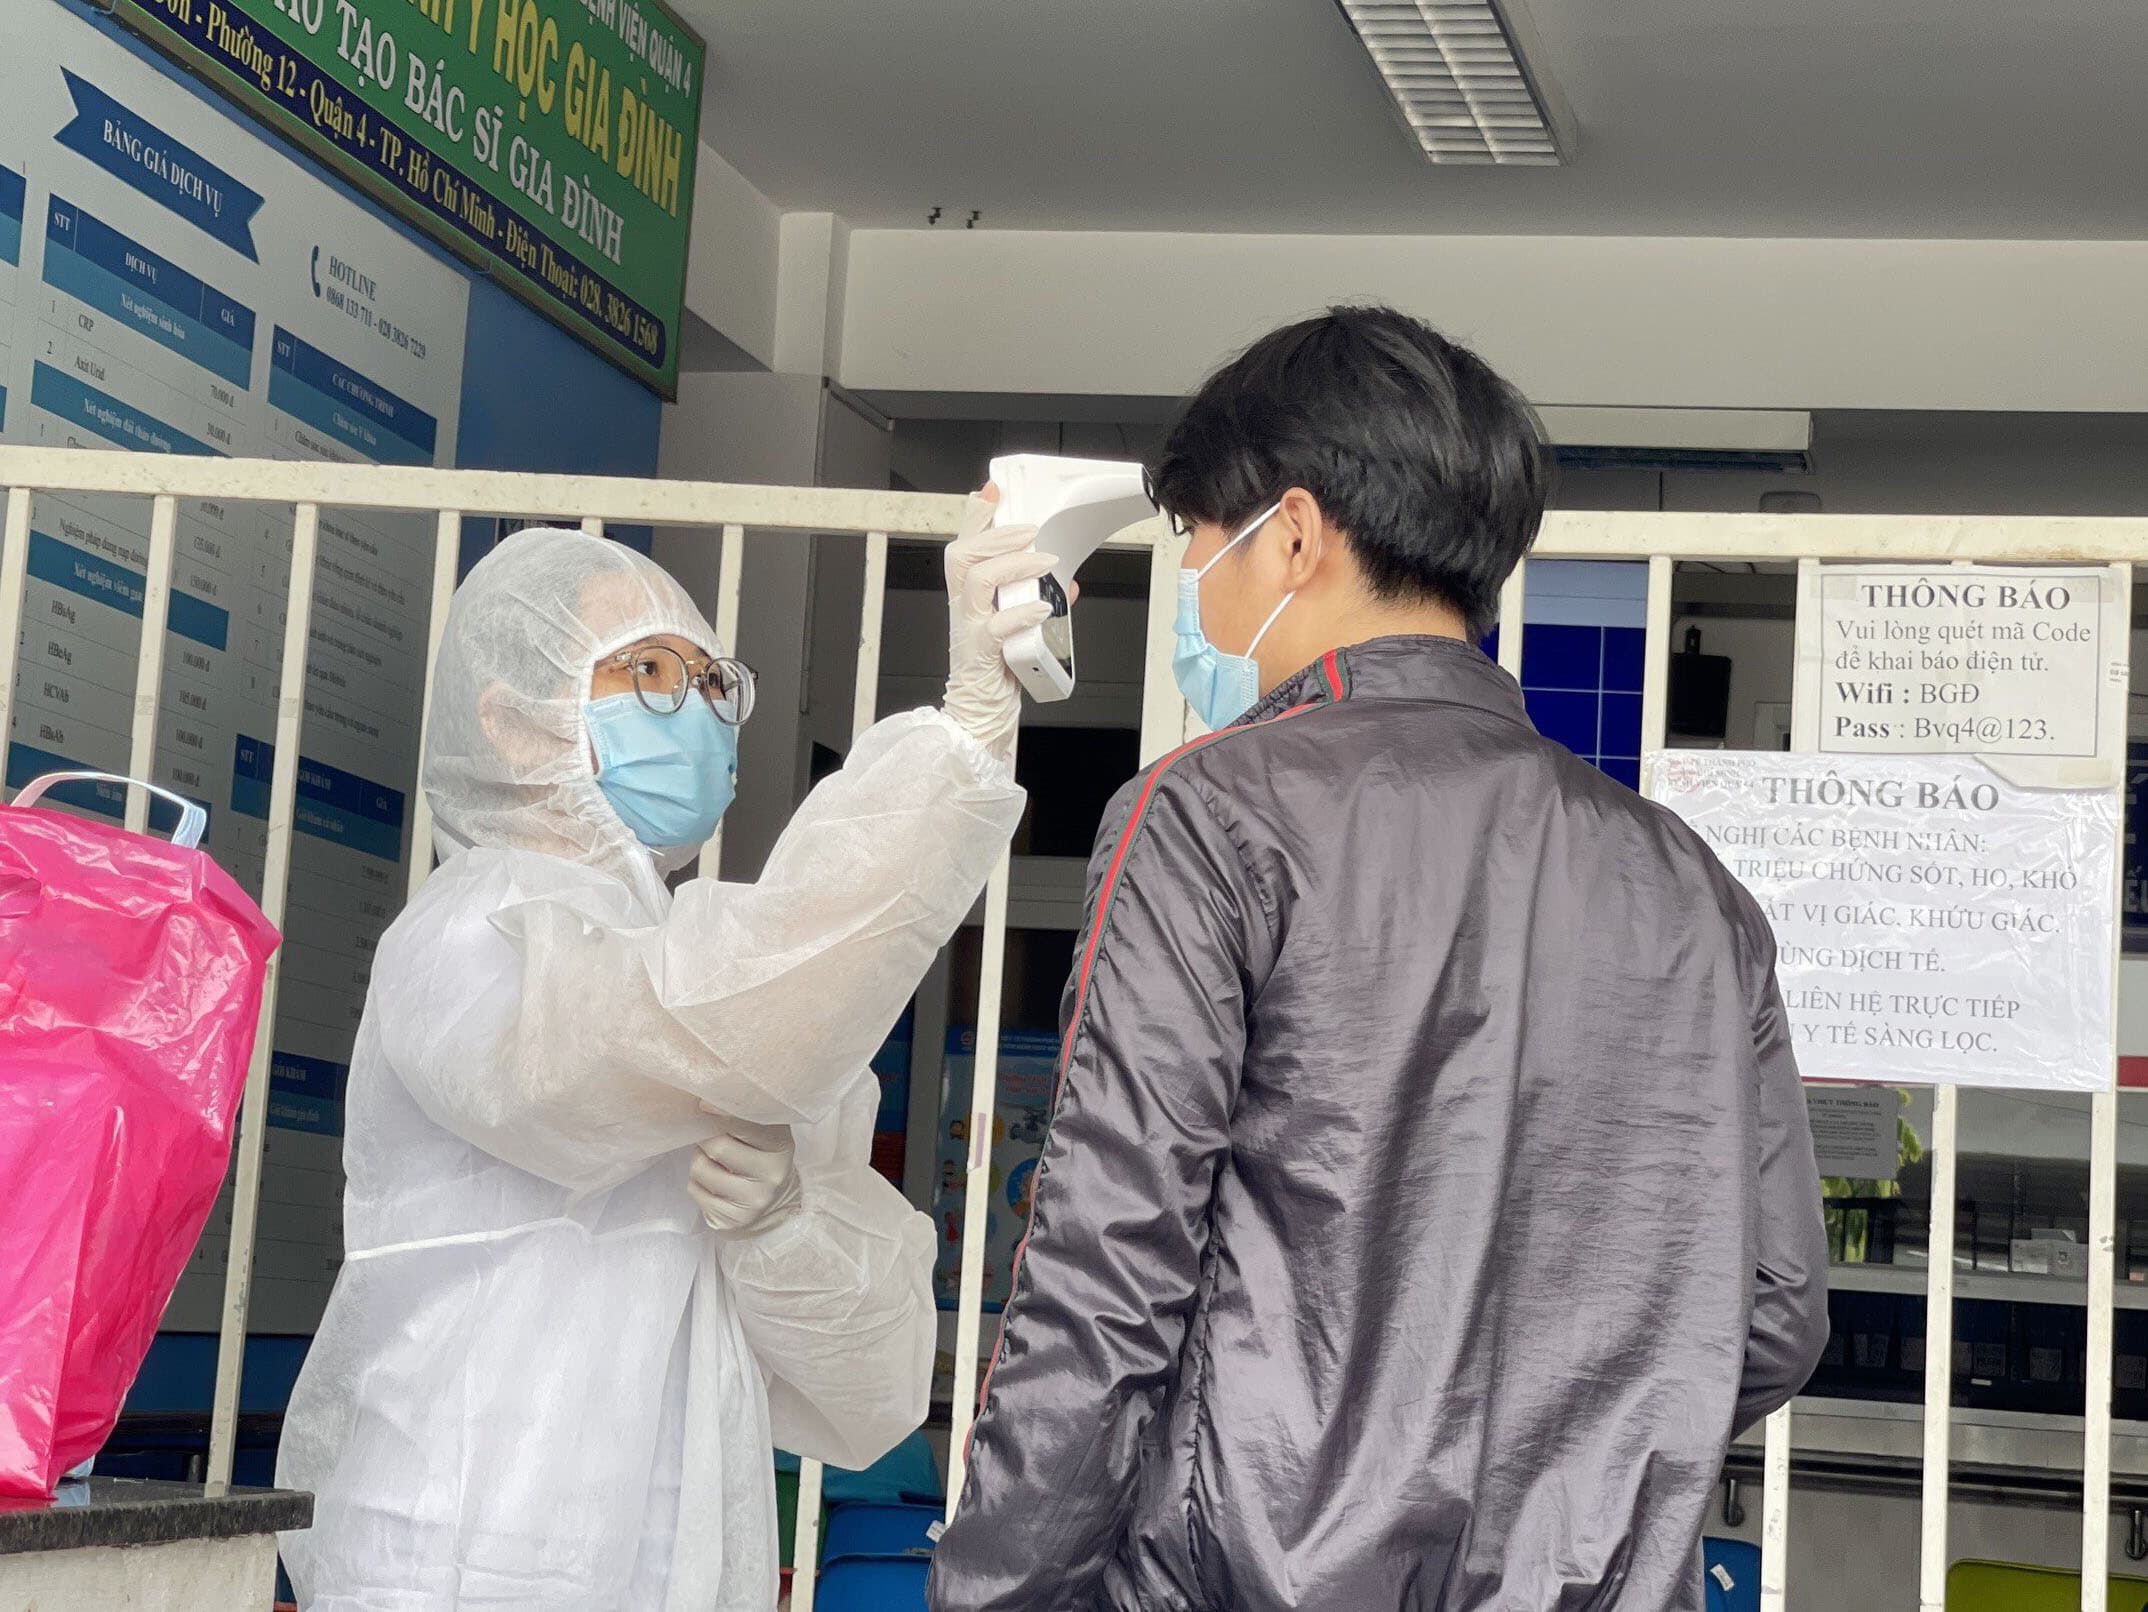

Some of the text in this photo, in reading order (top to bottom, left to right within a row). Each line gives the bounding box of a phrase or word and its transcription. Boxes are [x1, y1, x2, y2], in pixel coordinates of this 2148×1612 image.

[619, 0, 648, 62] VIỆN
[650, 29, 682, 94] QUẬN
[682, 61, 693, 98] 4
[493, 0, 559, 123] HỌC
[564, 41, 610, 165] GIA
[616, 76, 683, 219] ĐÌNH
[335, 0, 398, 91] TẠO
[404, 51, 465, 143] BÁC
[509, 134, 554, 216] GIA
[560, 174, 625, 266] ĐÌNH
[206, 1, 273, 92] Phường
[278, 54, 296, 99] 12
[310, 78, 352, 141] Quận
[355, 112, 367, 148] 4
[380, 126, 403, 176] TP.
[407, 148, 430, 193] Hồ
[432, 167, 458, 206] Chí
[459, 183, 495, 240] Minh
[506, 218, 537, 271] Điện
[541, 242, 579, 300] Thoại:
[103, 118, 224, 218] BẢNG GIÁ DỊCH VỤ
[54, 211, 72, 231] STT
[125, 252, 158, 285] DỊCH VỤ
[329, 255, 377, 302] HOTLINE
[326, 286, 345, 312] 0868
[78, 314, 95, 333] CRP
[221, 307, 235, 327] GIÁ
[1861, 577, 2071, 611] THÔNG BÁO
[51, 600, 76, 625] HBsAg
[1836, 619, 2092, 647] Vui lòng quét mã Code
[1835, 644, 1862, 670] để
[1868, 650, 1913, 672] khai
[1921, 651, 1959, 671] báo
[1966, 651, 2013, 675] điện
[1835, 681, 1980, 705] Wifi : BGĐ
[1835, 716, 1890, 738] Pass
[1914, 716, 2056, 744] Bvq4@123.
[1762, 769, 2000, 812] THÔNG BÁO
[1705, 822, 1987, 855] NGHỊ CÁC BỆNH NHÂN:
[1733, 856, 1804, 882] TRIỆU
[1811, 857, 1902, 884] CHỨNG
[1972, 866, 2015, 891] HO,
[1765, 897, 1795, 925] ẤT
[1802, 904, 1827, 927] VỊ
[1909, 904, 1985, 930] KHỨU
[1779, 940, 1834, 968] ÙNG
[1840, 949, 1902, 973] DỊCH
[1786, 985, 2021, 1020] LIÊN HỆ TRỰC TIẾP
[1802, 1023, 1821, 1043] Y
[1827, 1019, 1858, 1046] TẾ
[1864, 1022, 1934, 1049] SÀNG
[1940, 1031, 1998, 1055] LỌC.
